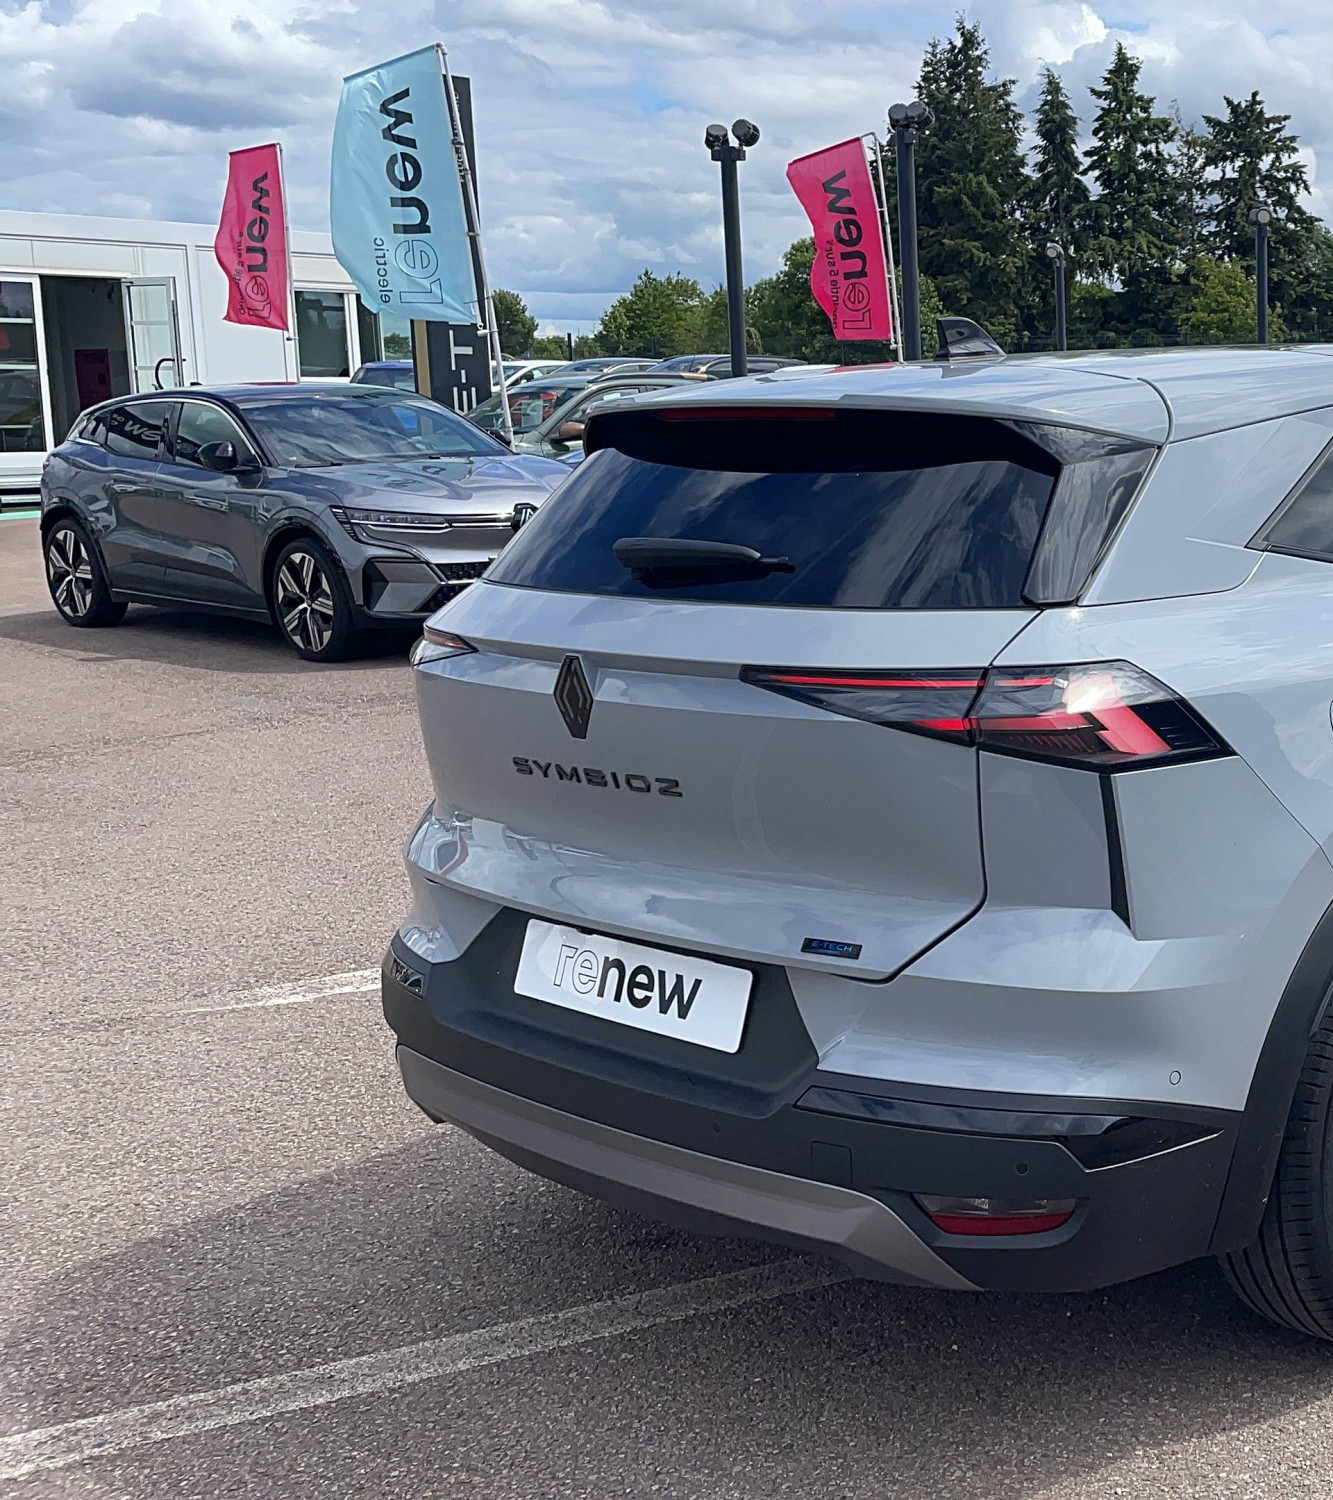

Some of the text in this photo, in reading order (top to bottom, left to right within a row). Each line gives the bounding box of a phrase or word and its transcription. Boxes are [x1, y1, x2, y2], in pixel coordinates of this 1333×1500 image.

[512, 756, 683, 797] SYMBIOZ
[812, 940, 853, 952] E-TECH
[553, 944, 703, 1020] renew
